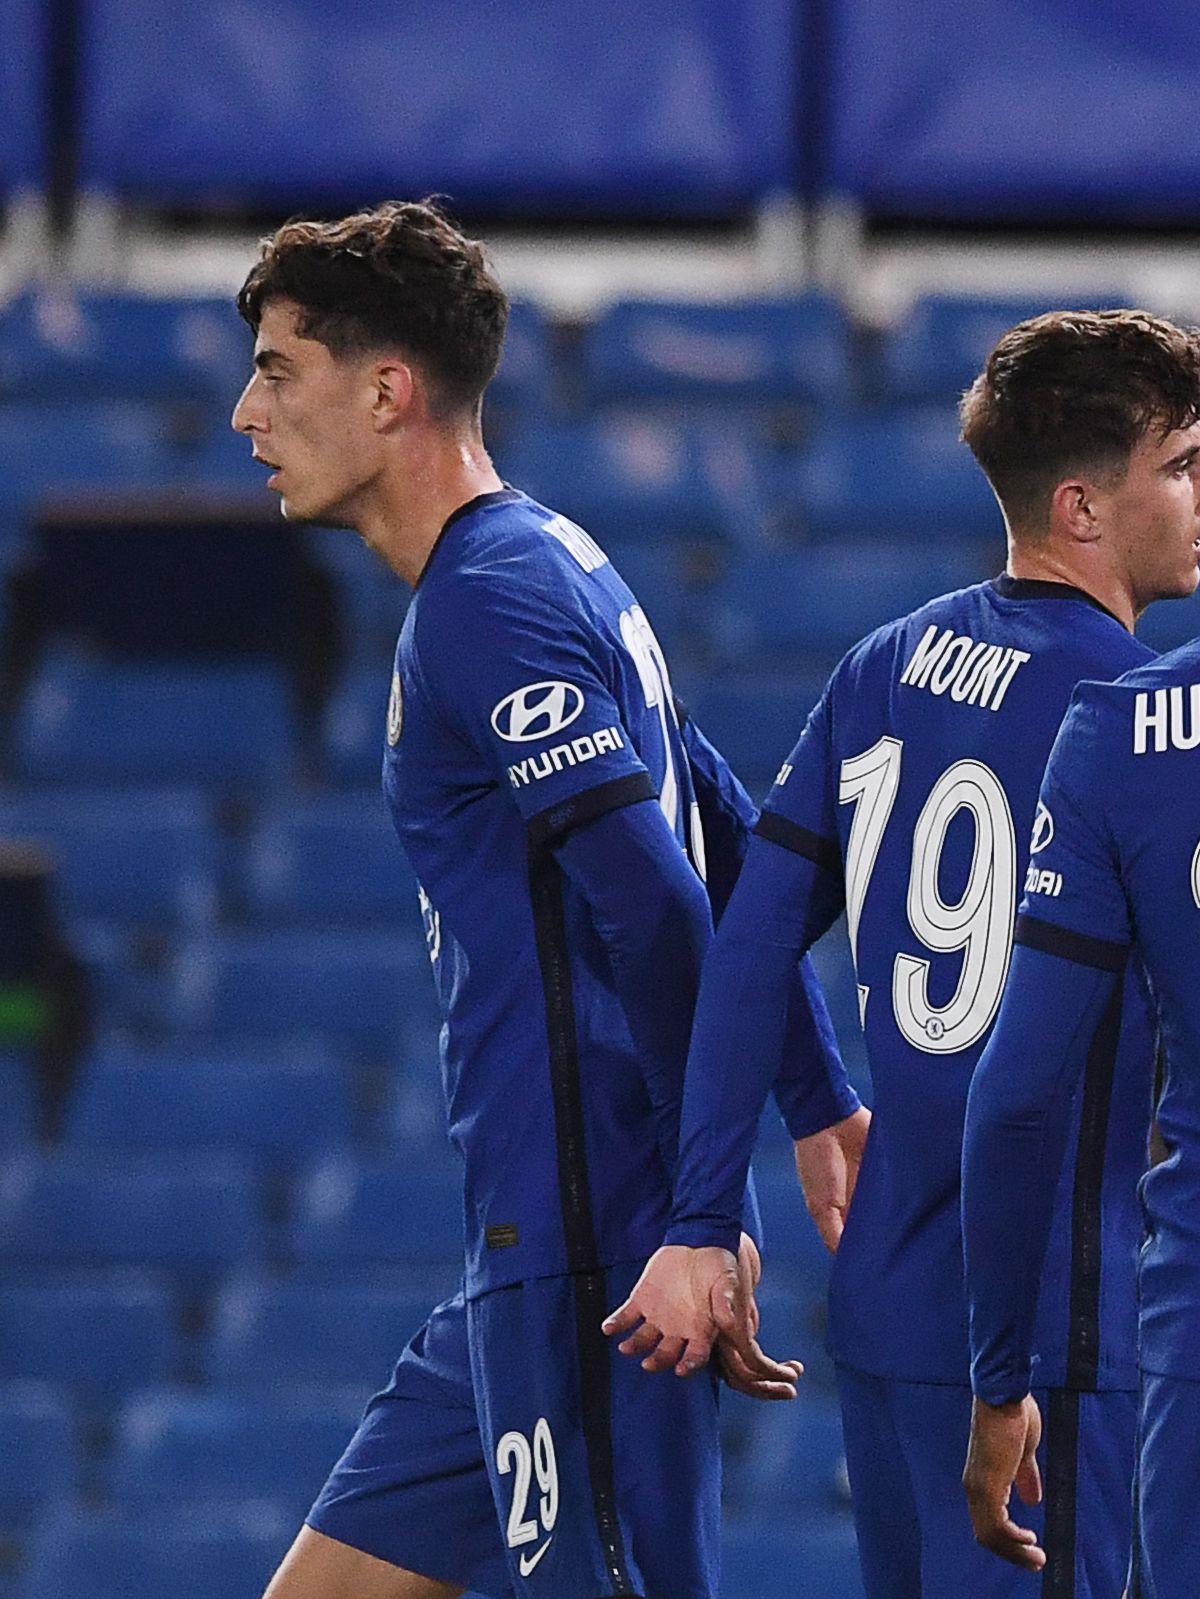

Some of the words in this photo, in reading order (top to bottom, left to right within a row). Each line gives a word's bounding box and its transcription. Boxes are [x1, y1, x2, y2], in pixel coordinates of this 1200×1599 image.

[900, 624, 1031, 711] MOUNT
[839, 735, 1017, 1055] 19
[496, 1417, 559, 1549] 29
